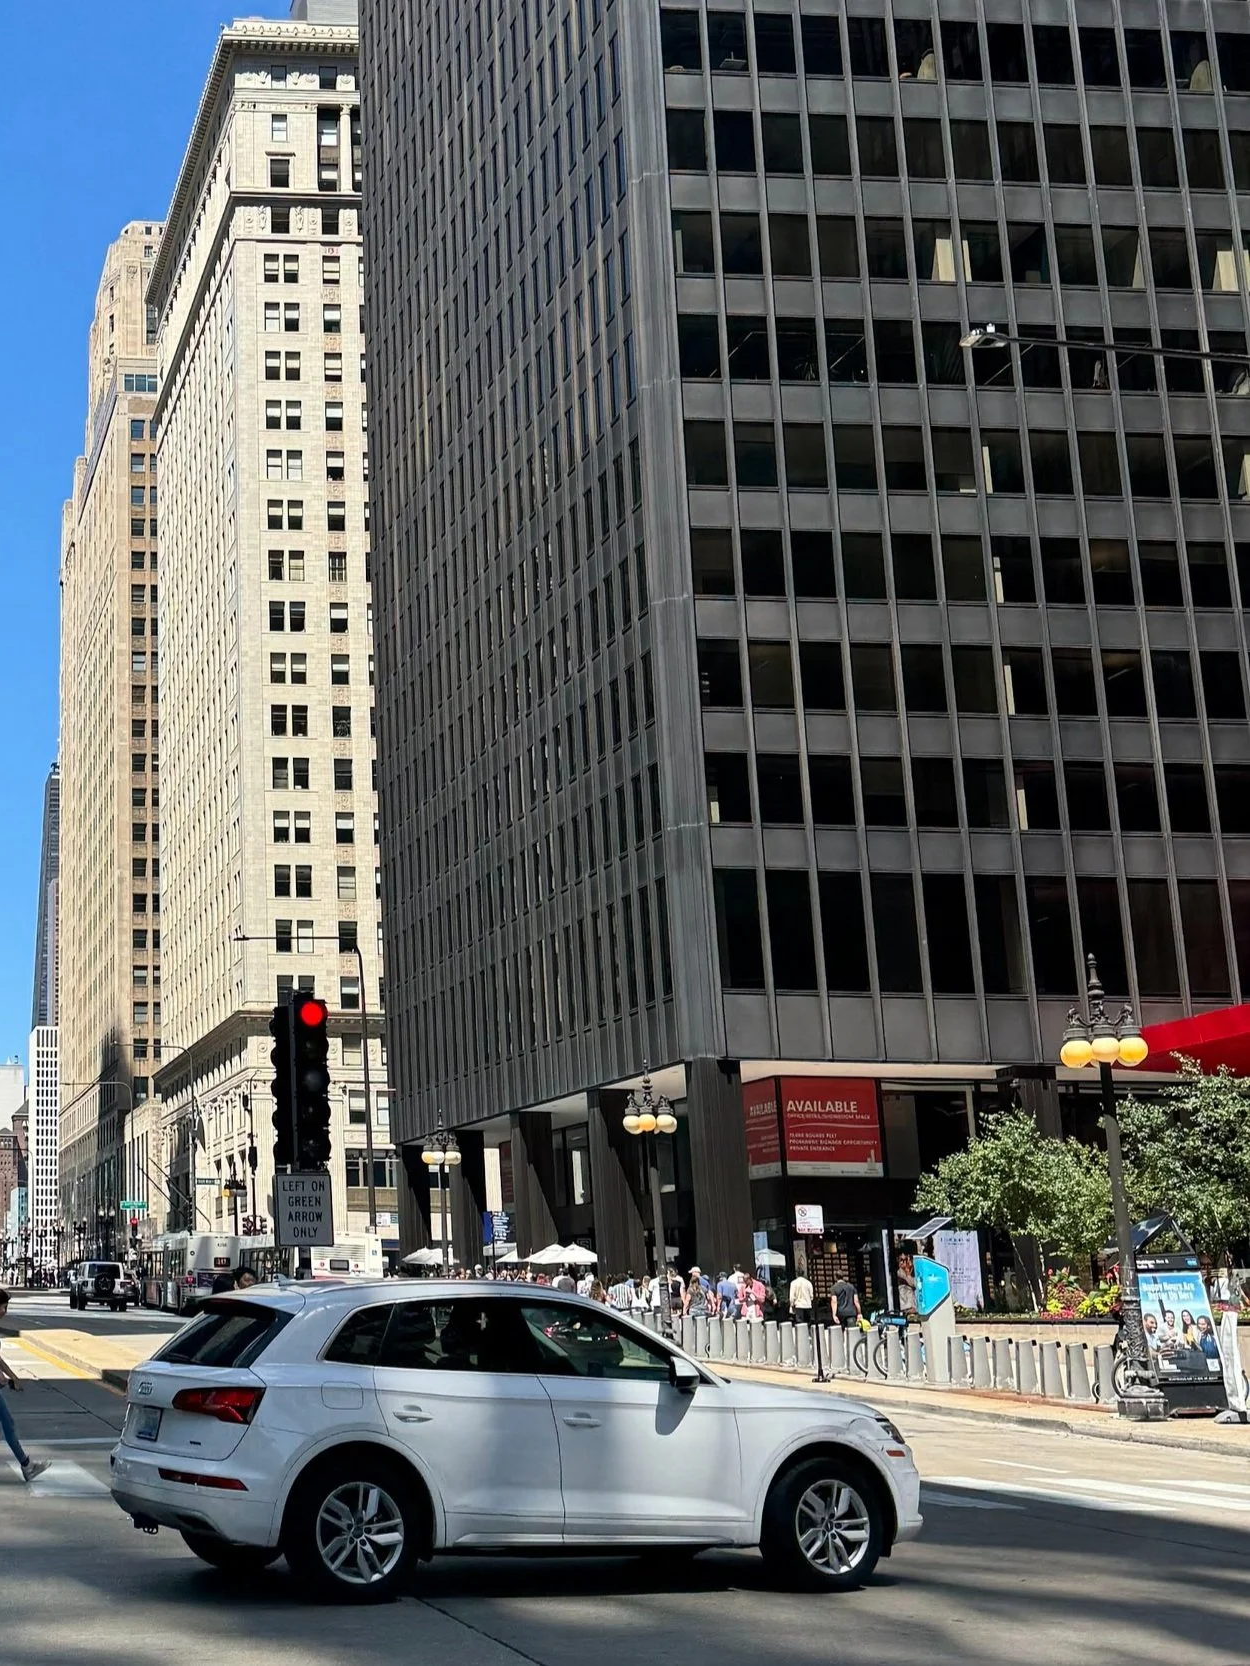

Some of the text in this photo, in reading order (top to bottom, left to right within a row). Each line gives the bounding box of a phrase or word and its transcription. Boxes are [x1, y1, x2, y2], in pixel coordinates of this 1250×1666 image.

[749, 1100, 777, 1117] AVAILABLE
[786, 1099, 858, 1113] AVAILABLE
[282, 1180, 325, 1192] LEFT ON
[288, 1196, 321, 1207] GREEN
[287, 1211, 323, 1222] ARROW
[293, 1227, 318, 1238] ONLY
